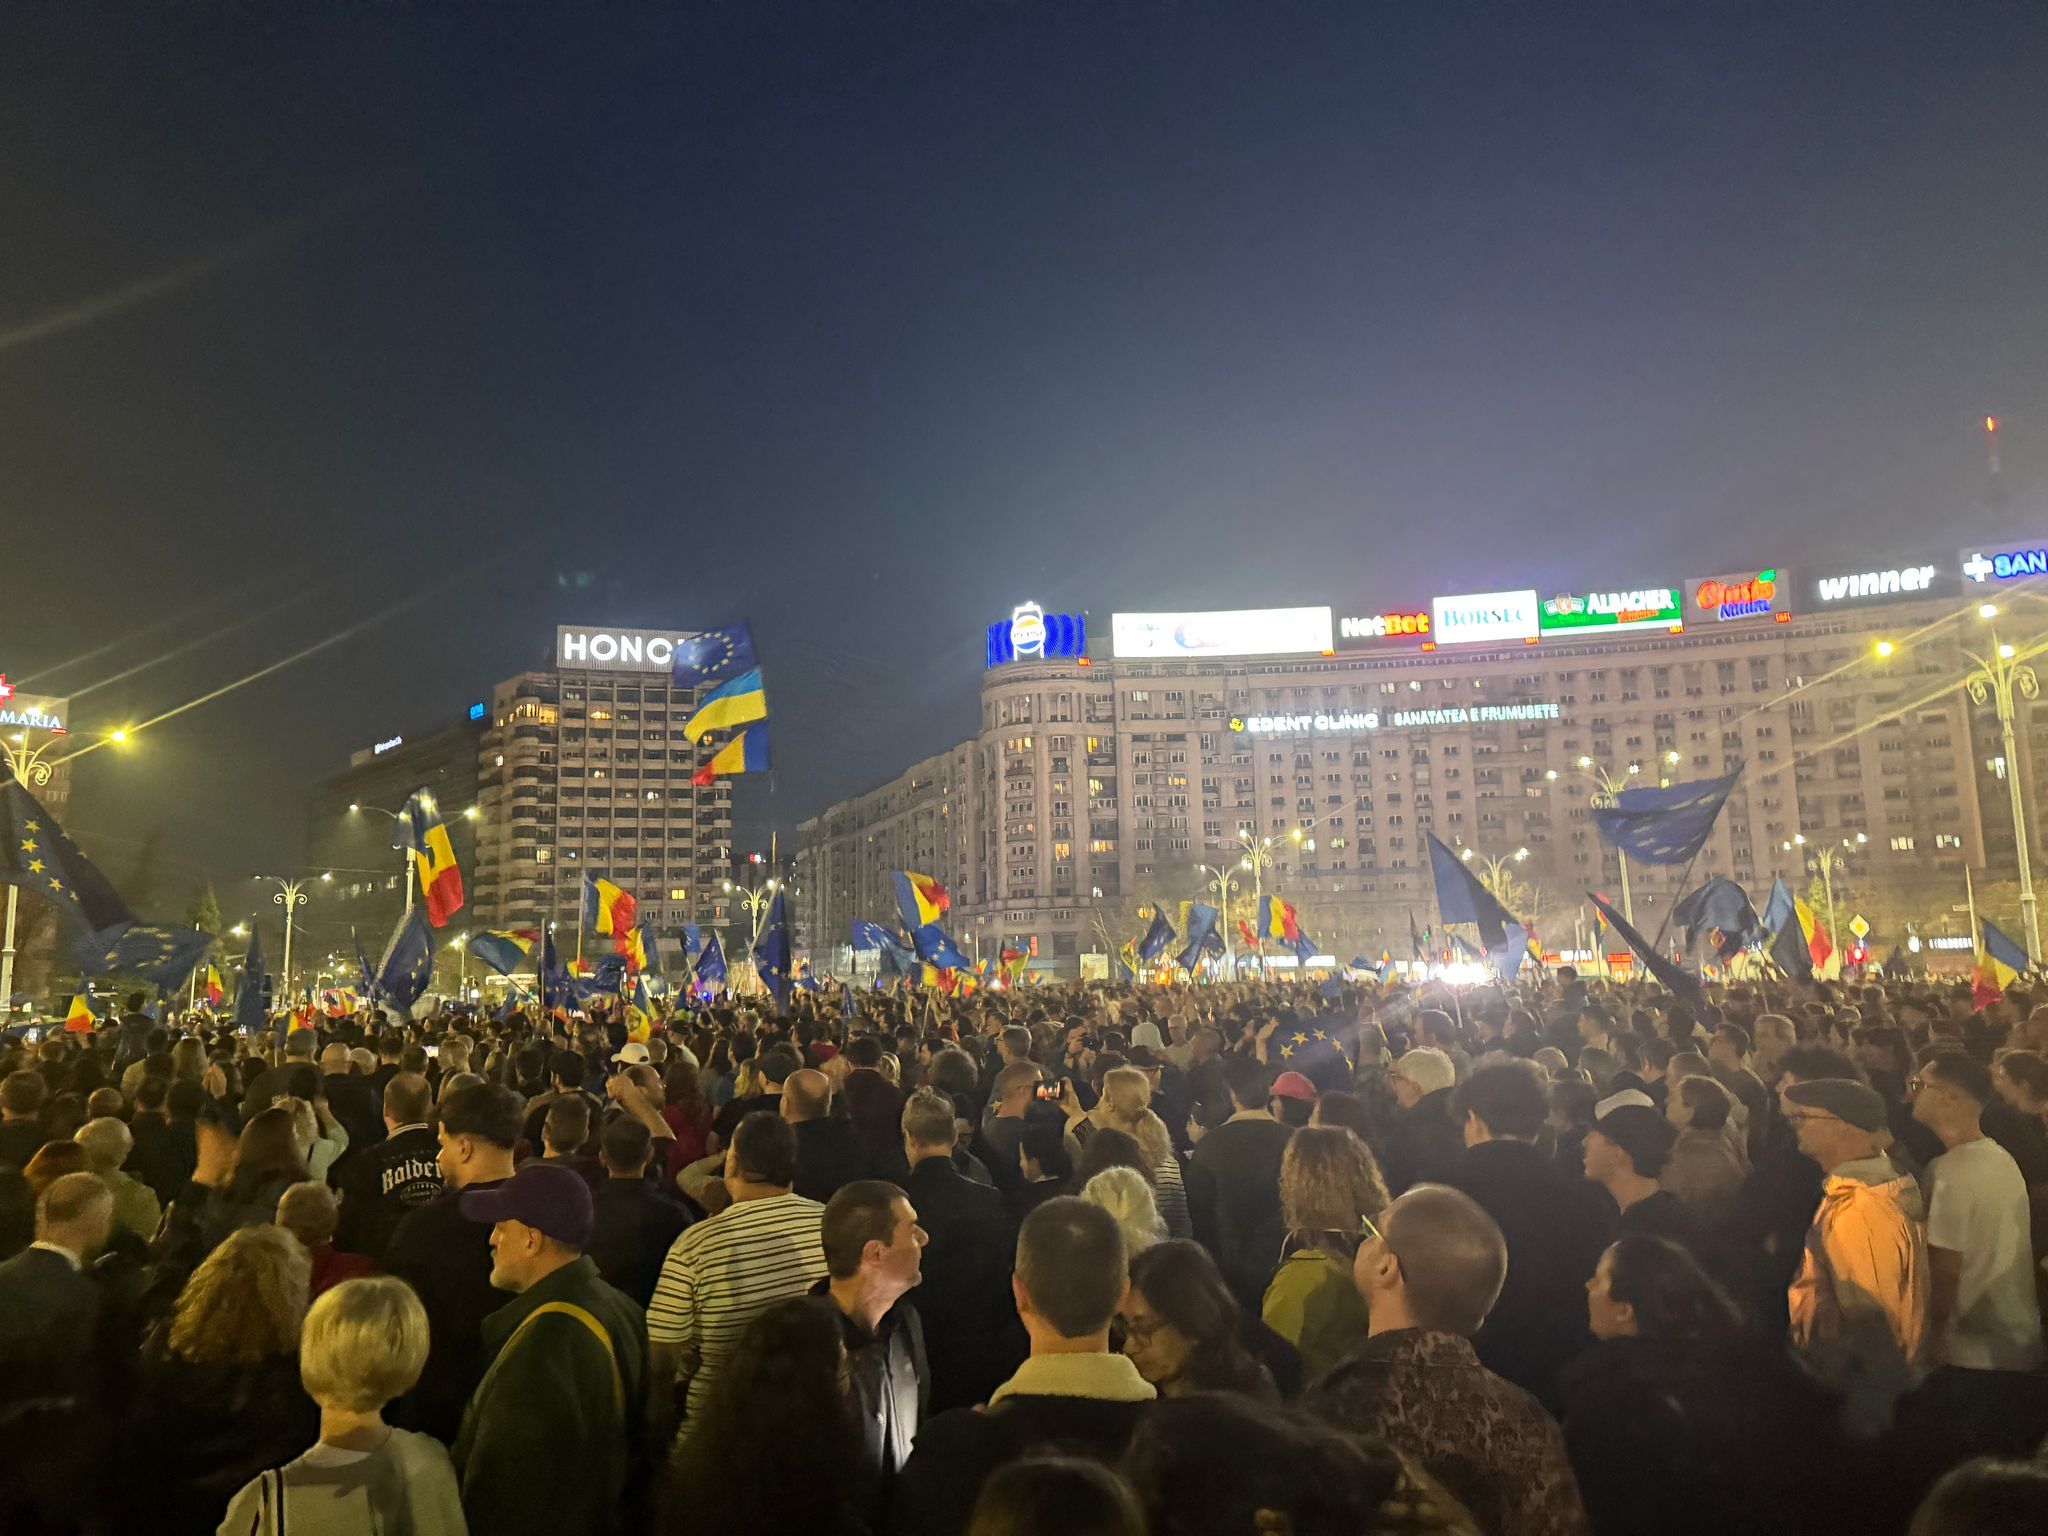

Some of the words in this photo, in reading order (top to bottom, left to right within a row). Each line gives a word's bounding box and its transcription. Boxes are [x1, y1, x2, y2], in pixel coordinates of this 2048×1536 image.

[1819, 565, 1935, 601] winner
[1443, 608, 1523, 627] BORSEC
[564, 632, 686, 665] HONO
[1314, 713, 1379, 730] CLINIC
